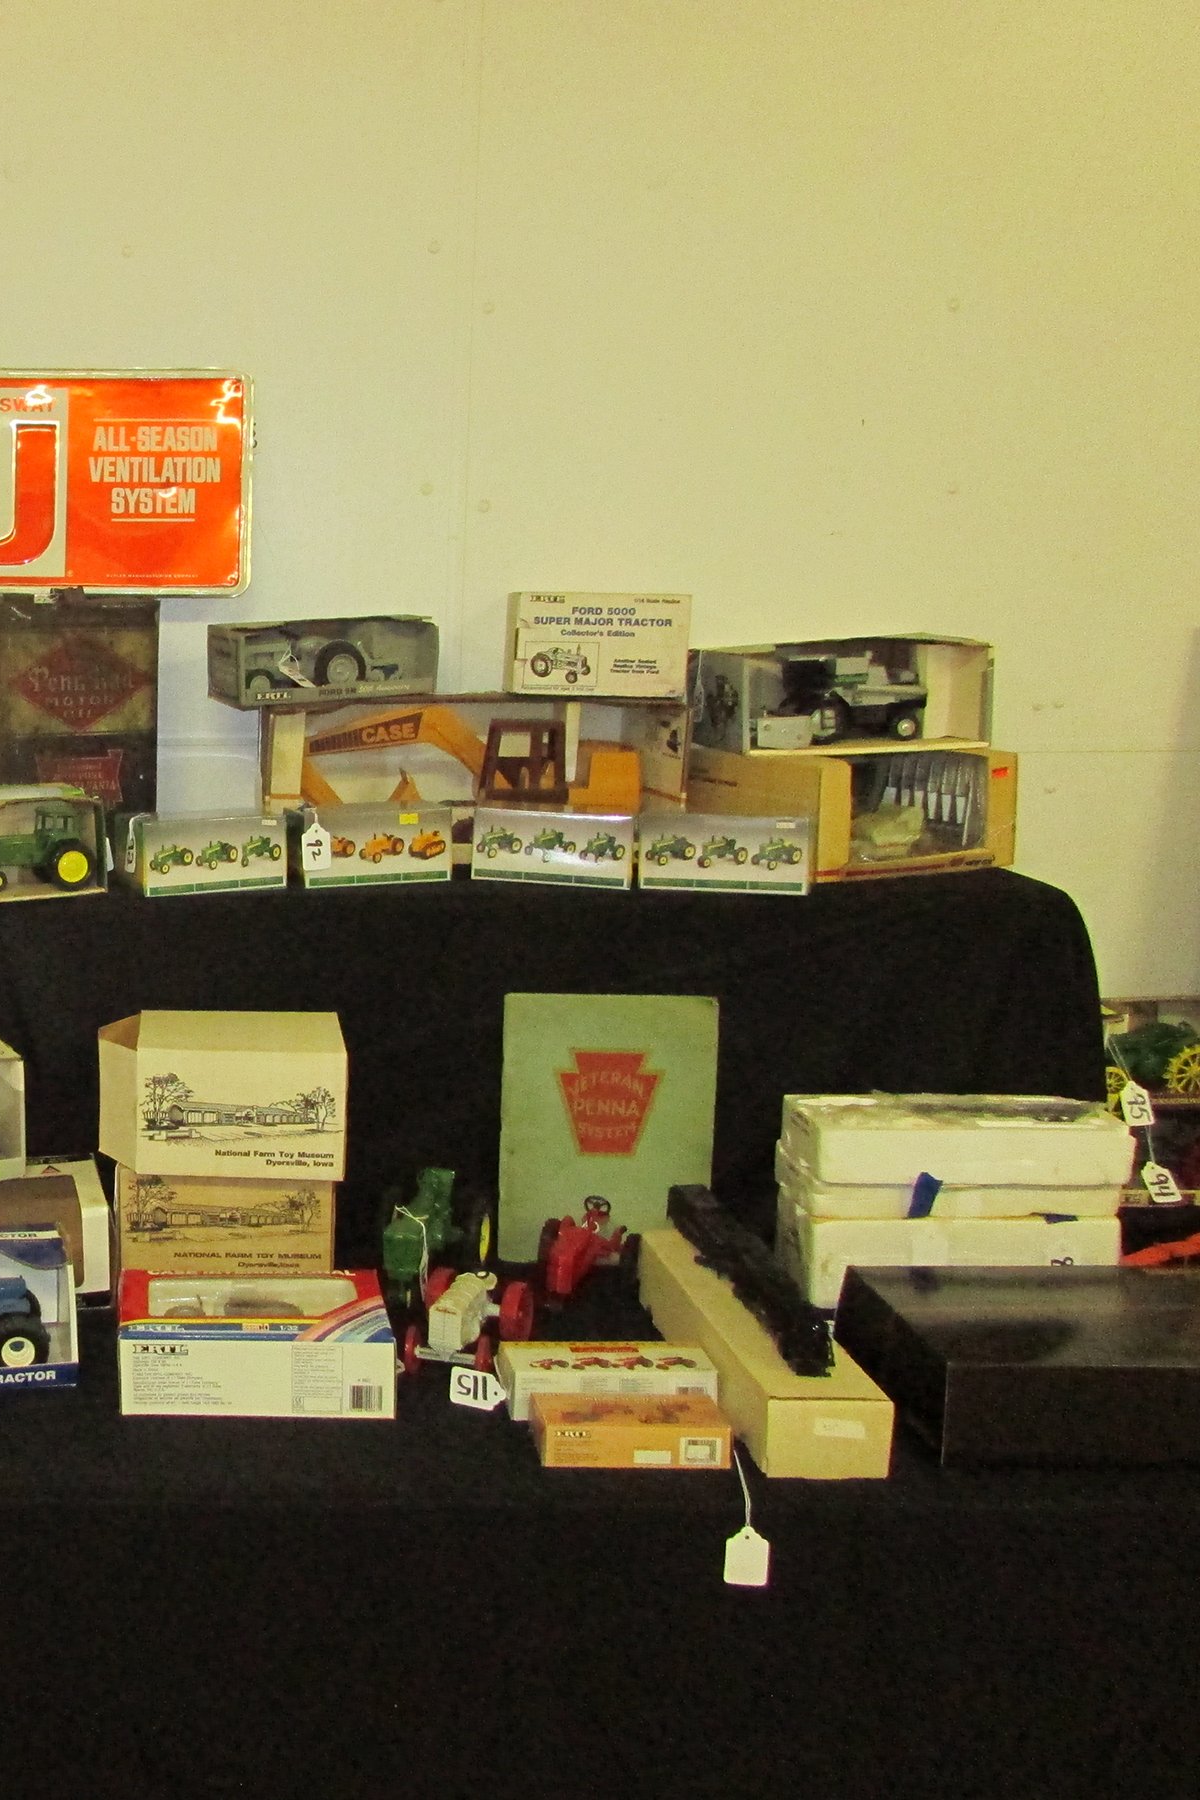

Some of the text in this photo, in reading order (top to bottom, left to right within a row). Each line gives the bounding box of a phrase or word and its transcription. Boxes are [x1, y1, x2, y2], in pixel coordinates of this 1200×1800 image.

[88, 456, 221, 483] VENTILATION
[110, 487, 196, 514] SYSTEM
[571, 606, 637, 617] FORD 5000
[533, 616, 673, 628] SUPER MAJOR TRACTOR
[606, 629, 636, 638] Edition
[361, 722, 416, 743] CASE
[306, 838, 323, 862] 92
[214, 1149, 335, 1159] National Farm Toy Museum
[173, 1251, 222, 1259] NATIONAL
